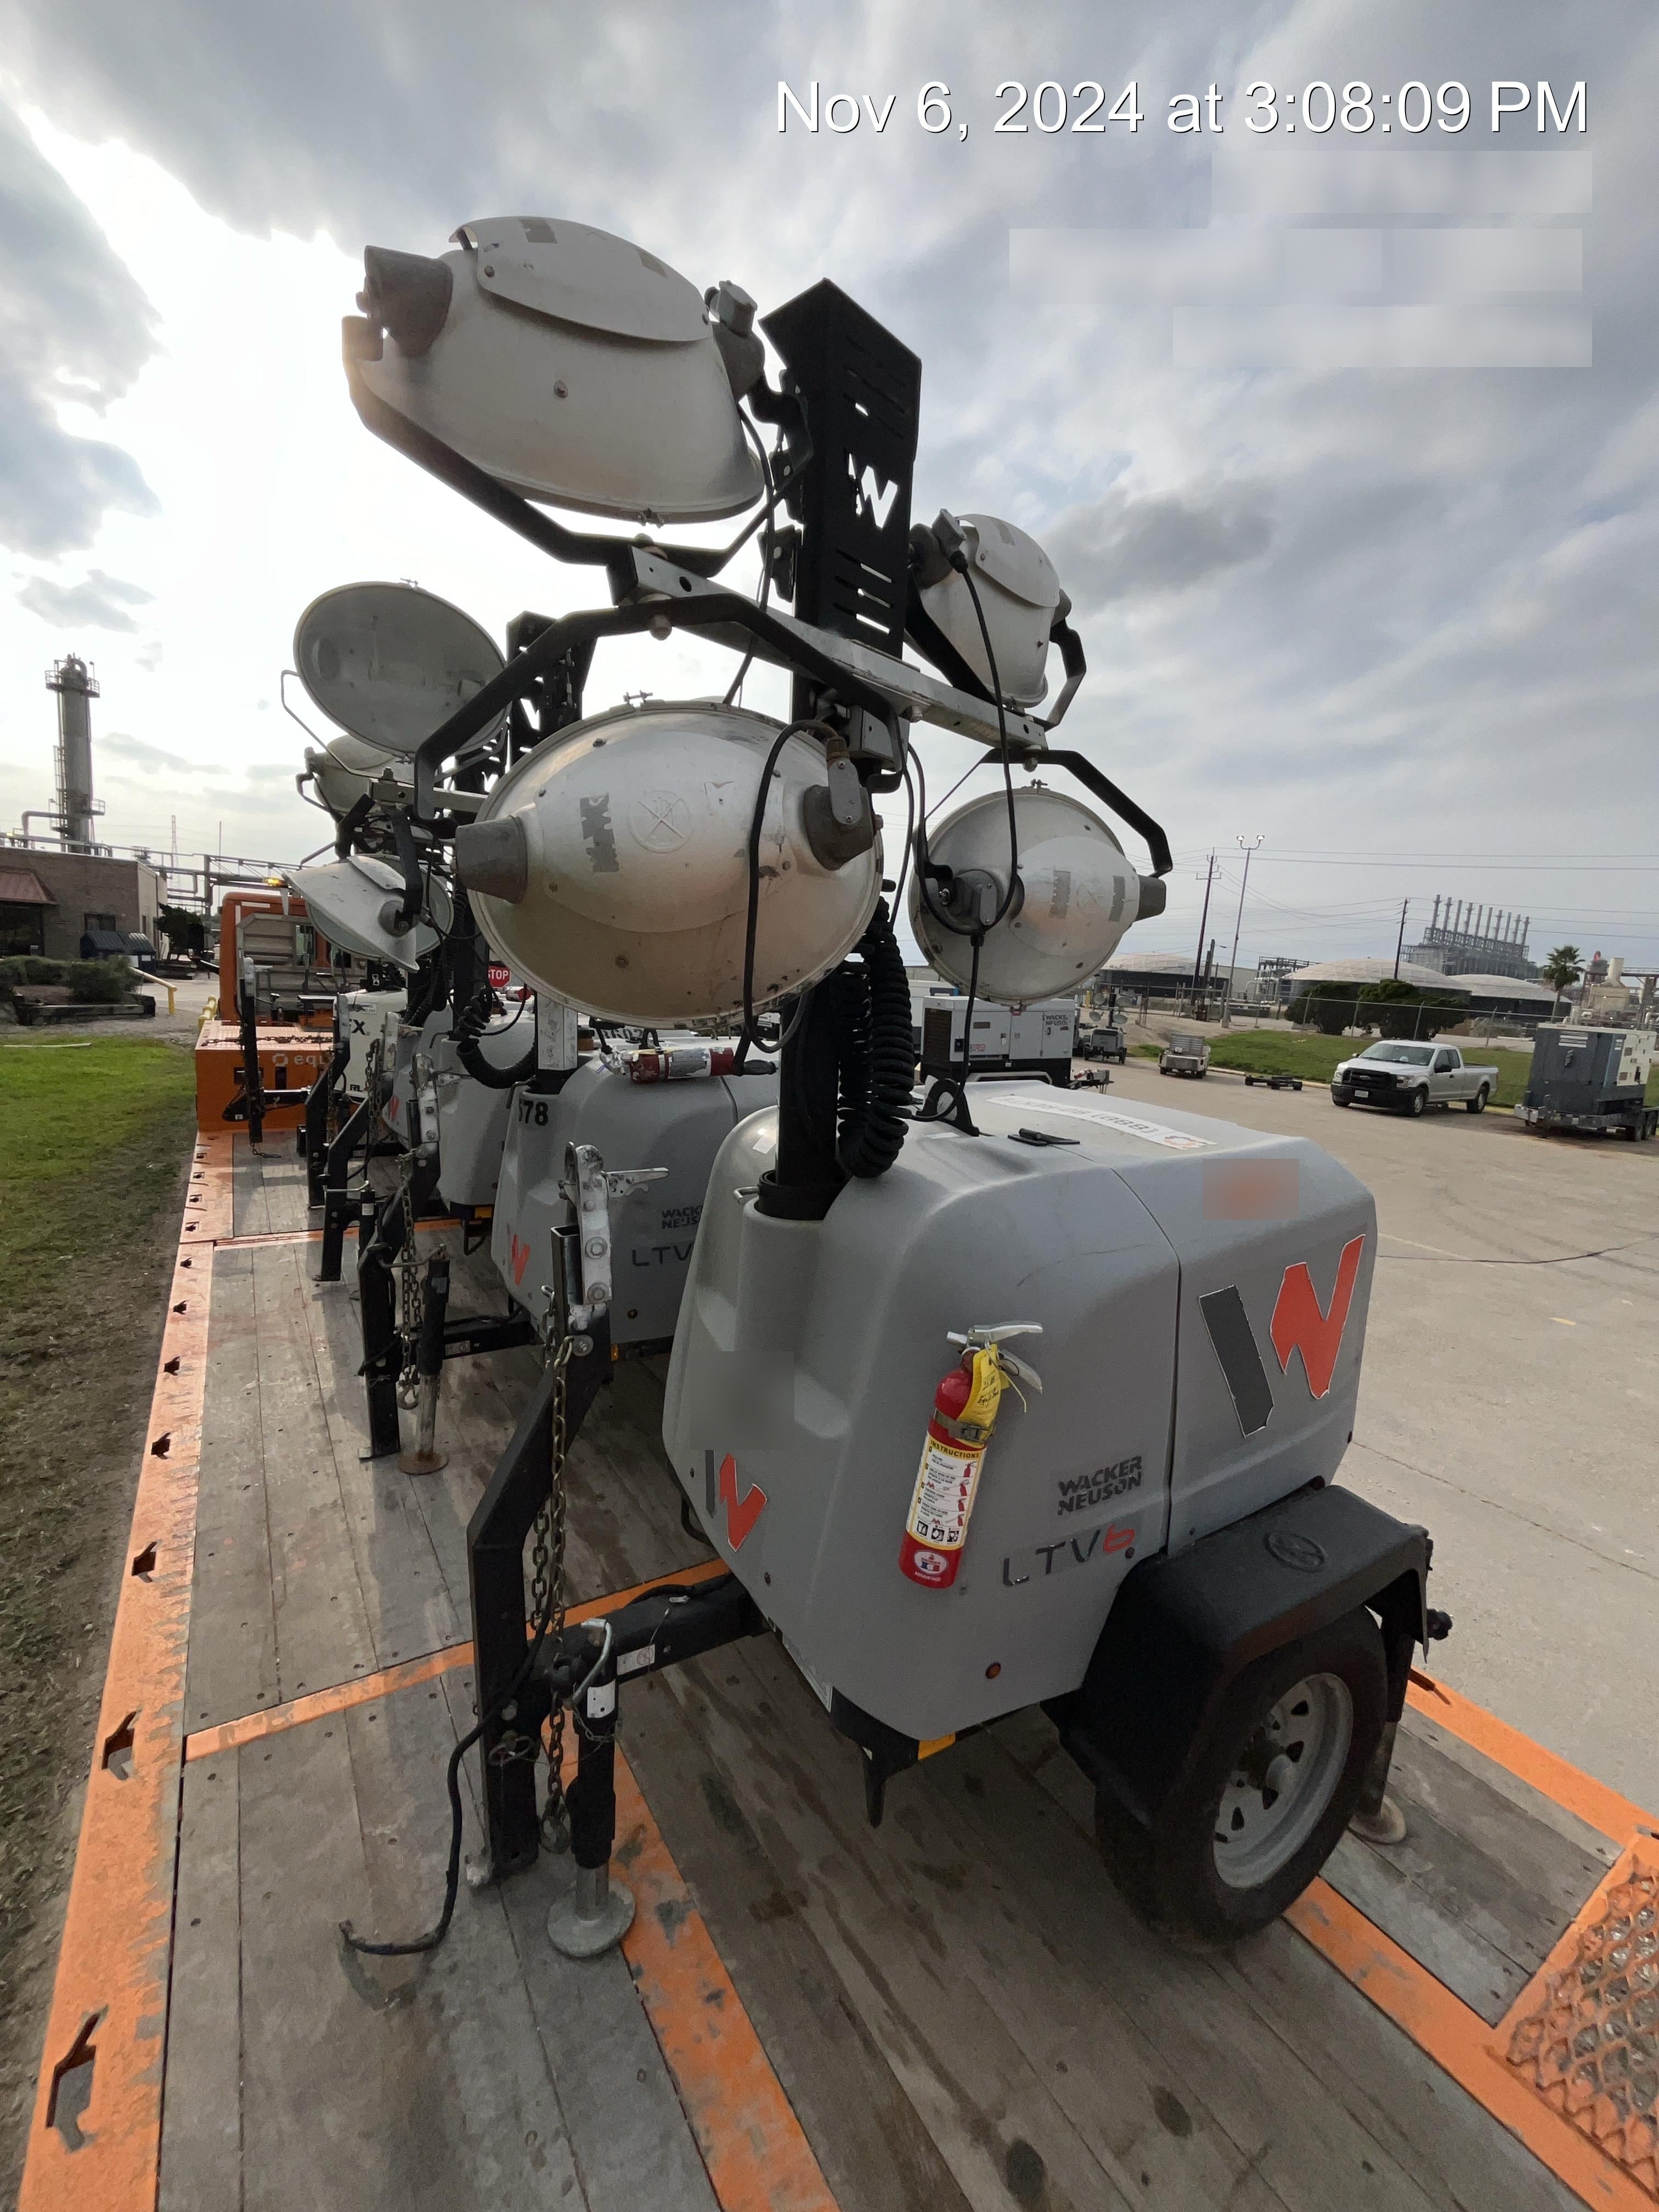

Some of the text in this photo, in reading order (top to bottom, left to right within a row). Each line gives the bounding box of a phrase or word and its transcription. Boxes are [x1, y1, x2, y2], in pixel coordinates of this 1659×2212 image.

[662, 1205, 703, 1218] WACK
[930, 1440, 980, 1459] INSTRUCTIONS
[1058, 1455, 1142, 1496] WACKER
[1058, 1471, 1142, 1515] NEUSON
